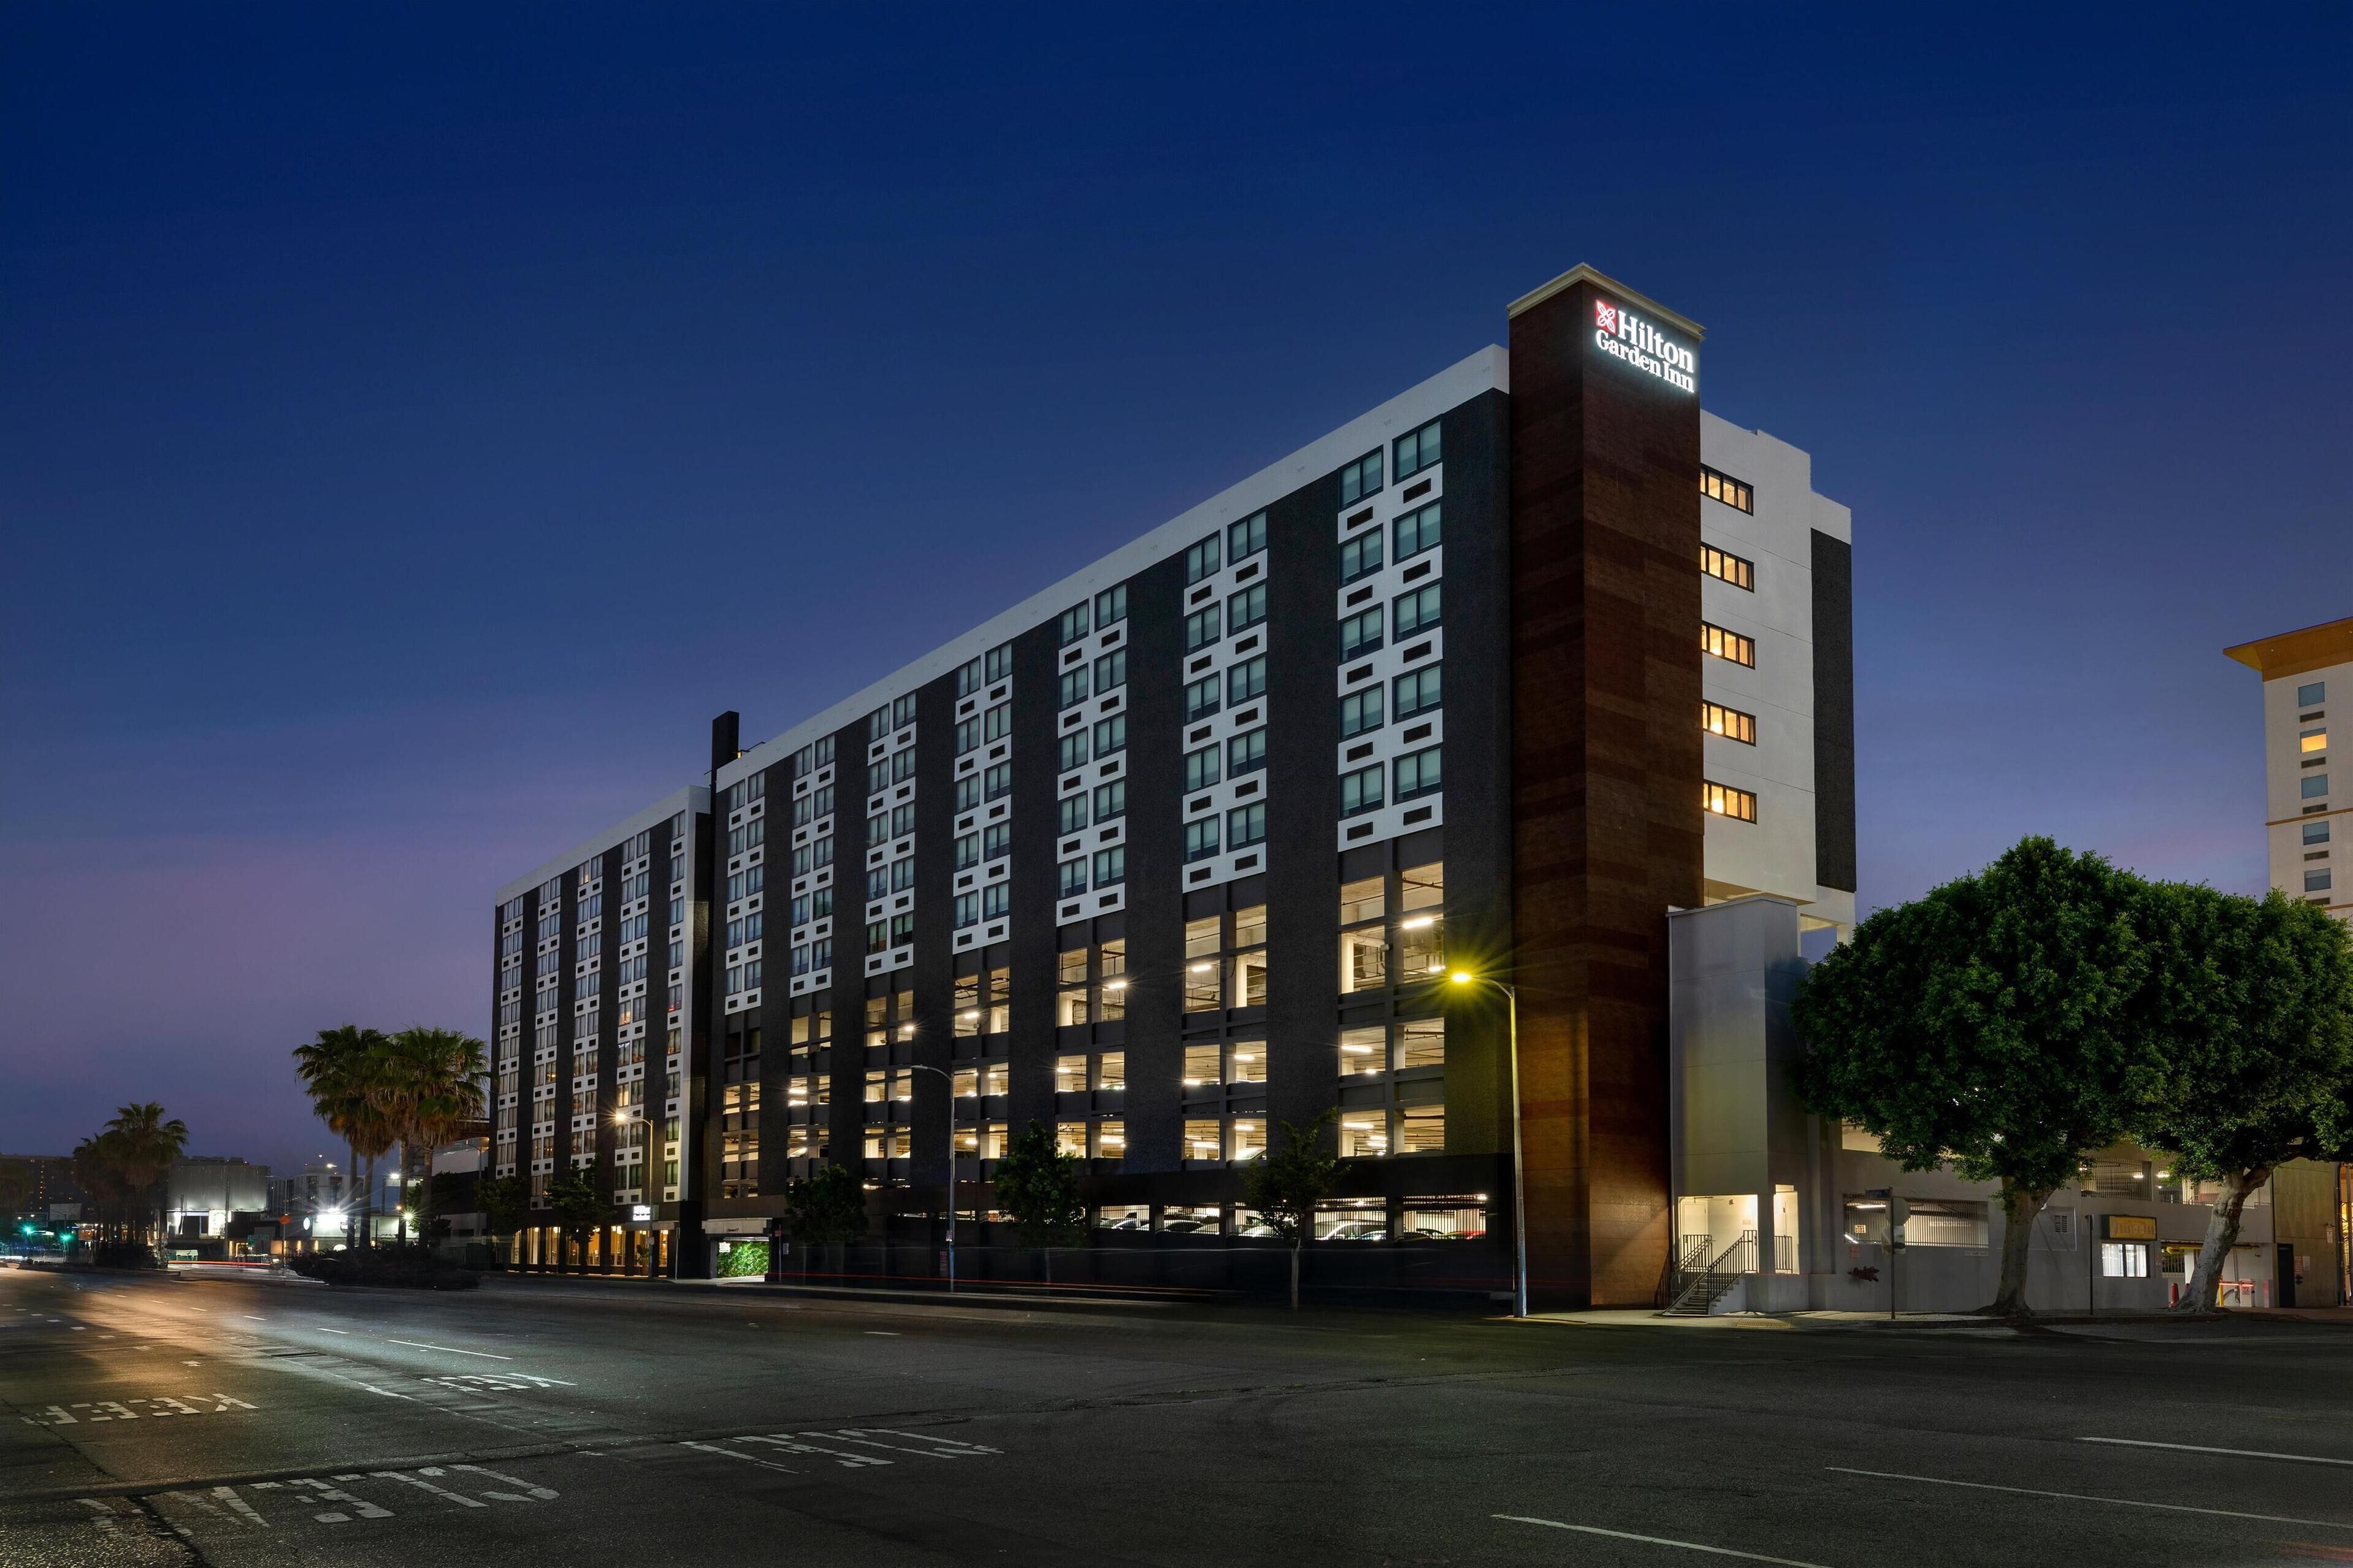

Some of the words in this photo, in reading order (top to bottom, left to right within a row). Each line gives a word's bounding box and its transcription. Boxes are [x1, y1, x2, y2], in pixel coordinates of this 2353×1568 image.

[1596, 329, 1662, 378] Garden
[1662, 361, 1695, 393] Inn
[1618, 310, 1694, 373] Hilton
